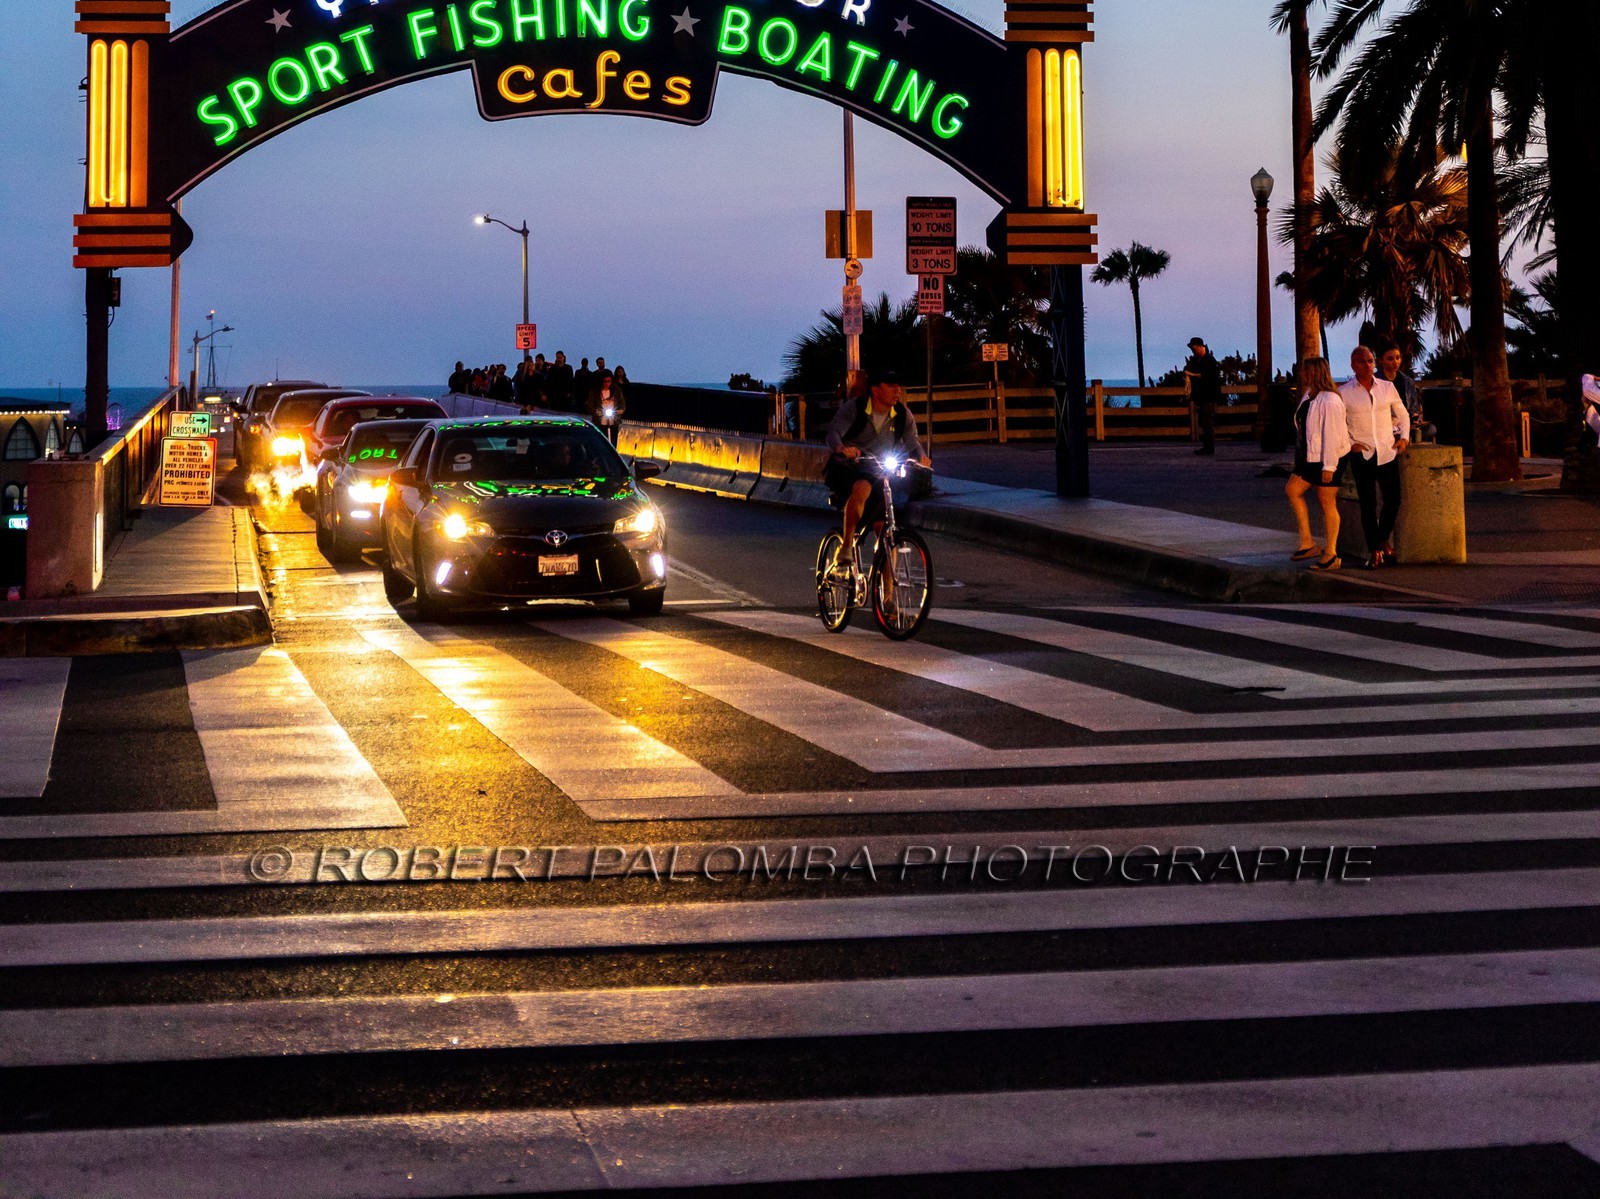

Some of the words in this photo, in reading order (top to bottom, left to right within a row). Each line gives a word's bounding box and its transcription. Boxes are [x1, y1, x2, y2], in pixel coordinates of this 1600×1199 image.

[197, 24, 374, 146] SPORT
[717, 5, 969, 139] BOATING
[911, 222, 921, 232] 10
[926, 222, 952, 232] TONS
[912, 259, 918, 269] 3
[923, 259, 951, 269] TONS
[923, 277, 939, 290] NO
[523, 337, 530, 347] 5
[173, 426, 207, 435] CROSSWALK
[164, 470, 211, 479] PROHIBITED
